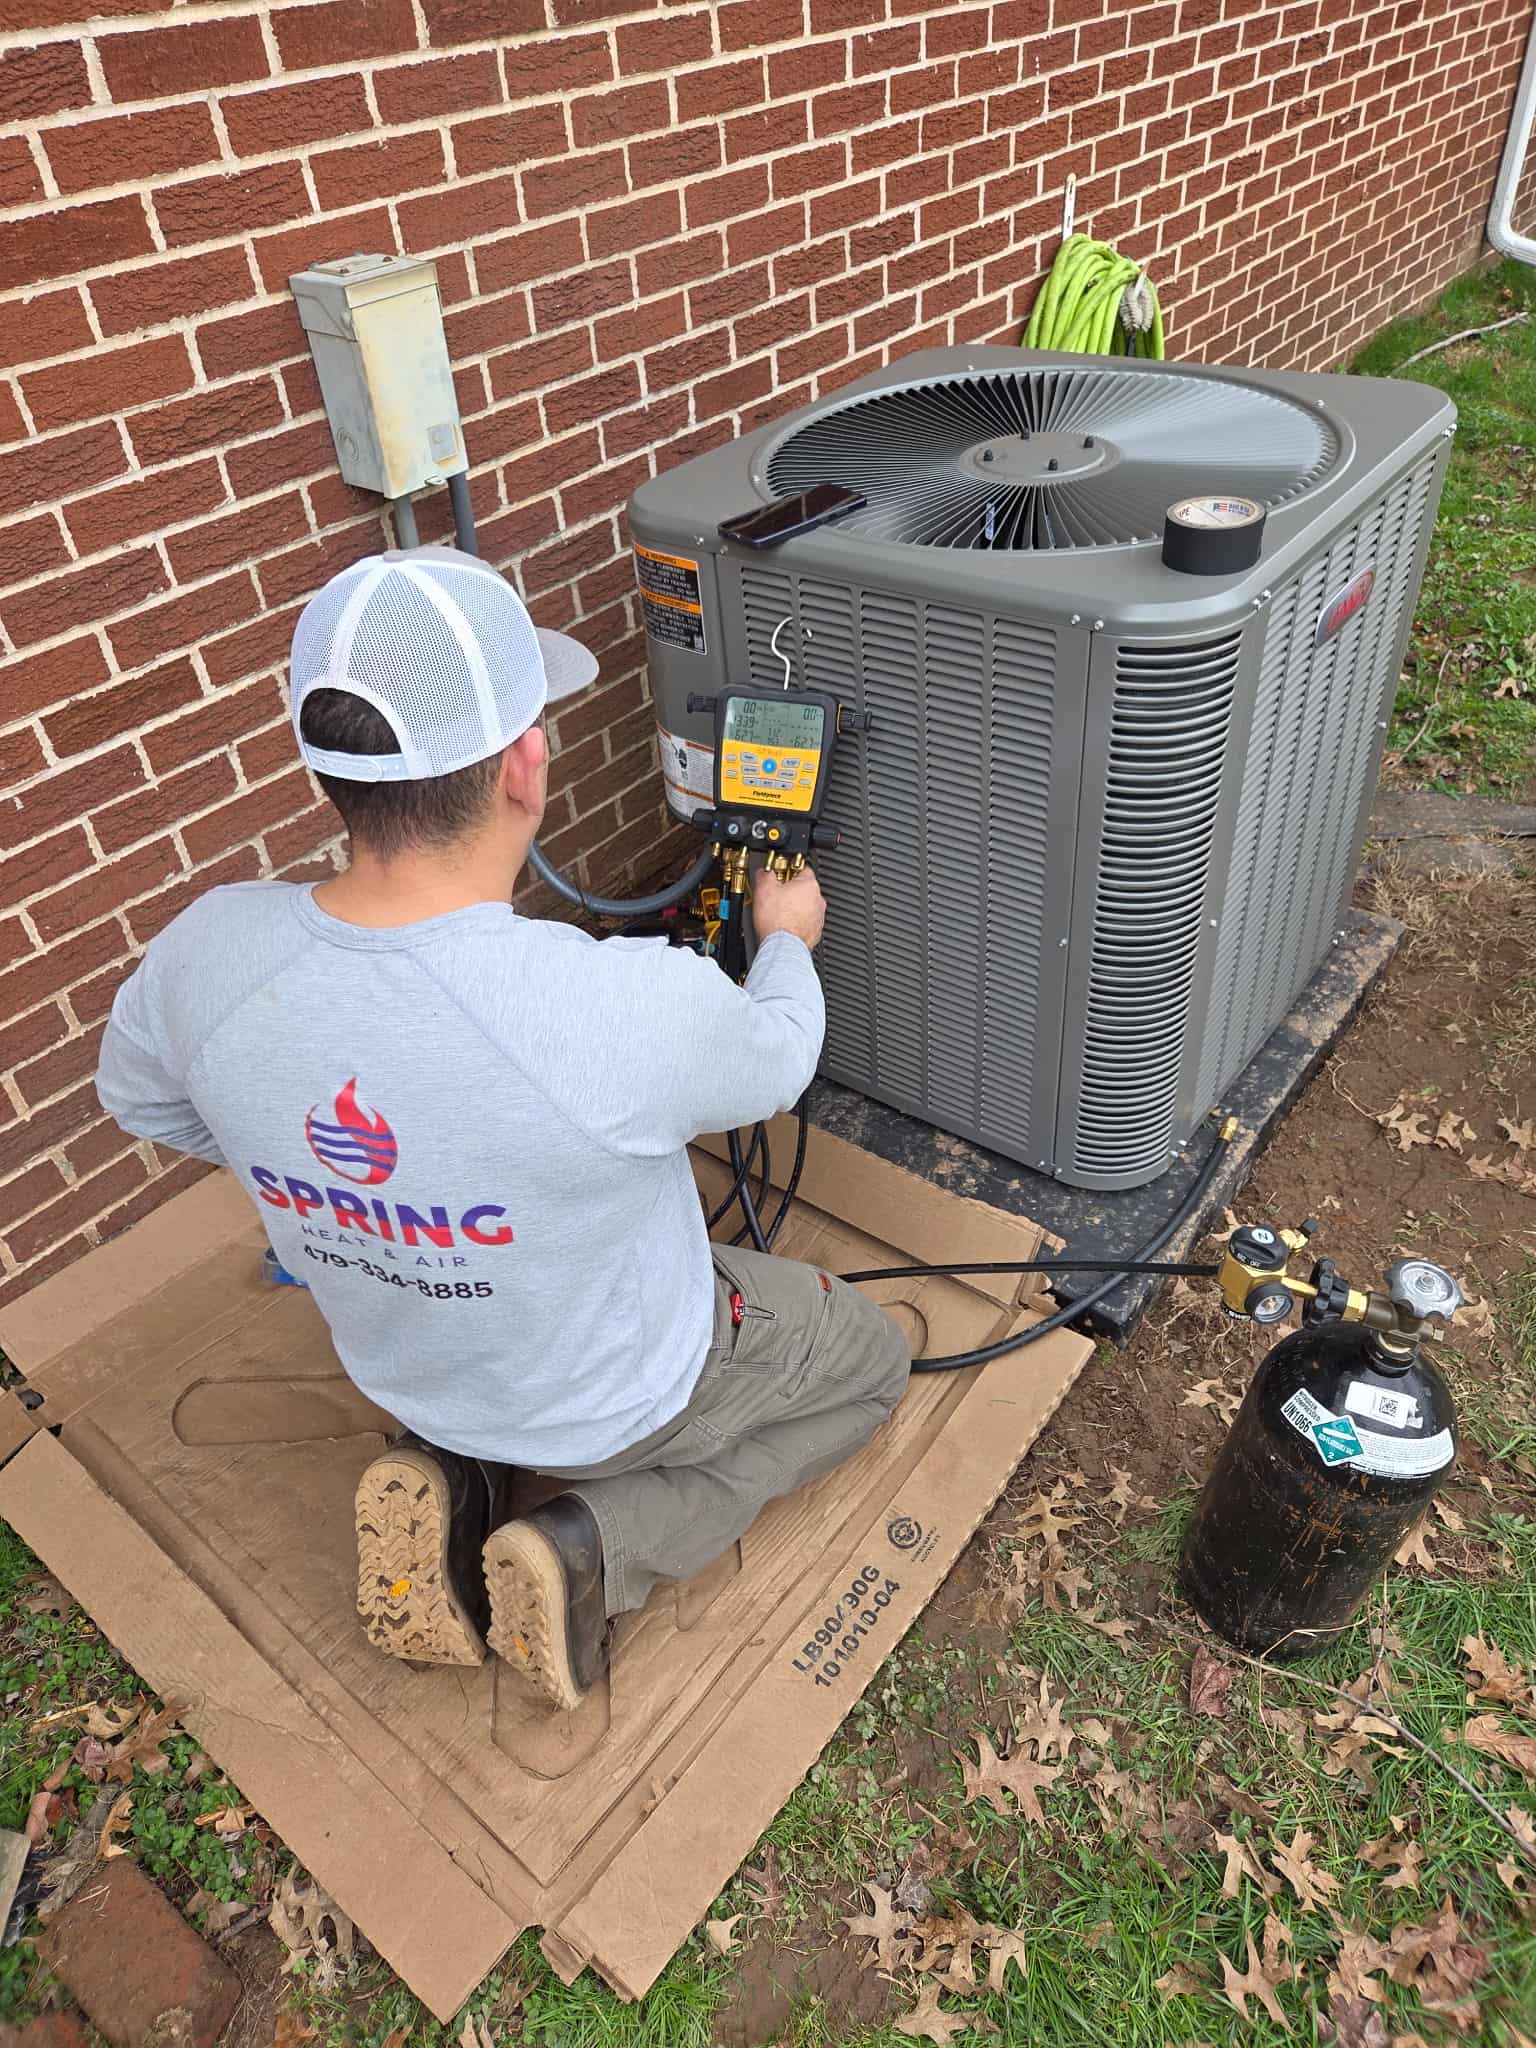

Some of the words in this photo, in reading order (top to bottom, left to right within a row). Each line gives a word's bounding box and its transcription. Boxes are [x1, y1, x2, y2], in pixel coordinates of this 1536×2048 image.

[250, 1165, 514, 1249] SPRING
[301, 1223, 367, 1248] HEAT
[384, 1248, 398, 1260] &
[416, 1255, 469, 1268] AIR
[303, 1244, 494, 1299] 479-334-8885
[1283, 1401, 1313, 1433] UN1066
[1327, 1451, 1335, 1460] 2
[814, 1578, 901, 1688] 101010-04
